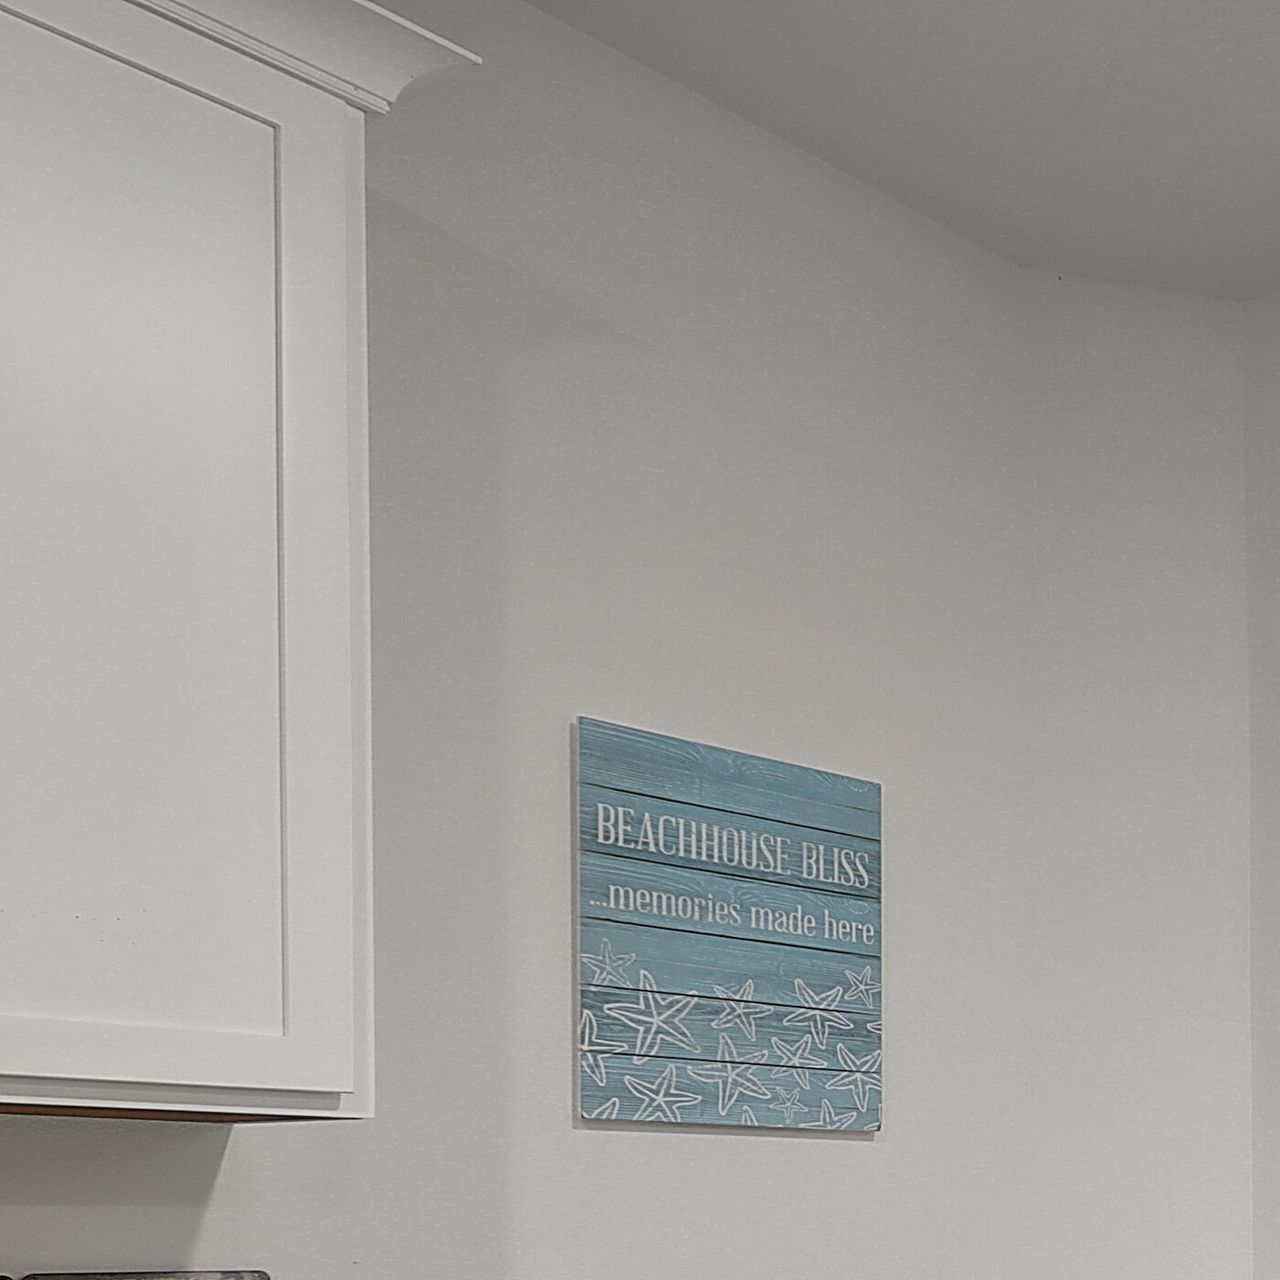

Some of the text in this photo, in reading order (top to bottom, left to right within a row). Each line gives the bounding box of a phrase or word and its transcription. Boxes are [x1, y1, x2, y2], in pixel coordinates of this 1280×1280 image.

[597, 802, 869, 888] BEACHHOUSE BLISS
[750, 903, 817, 937] made
[824, 909, 875, 945] here
